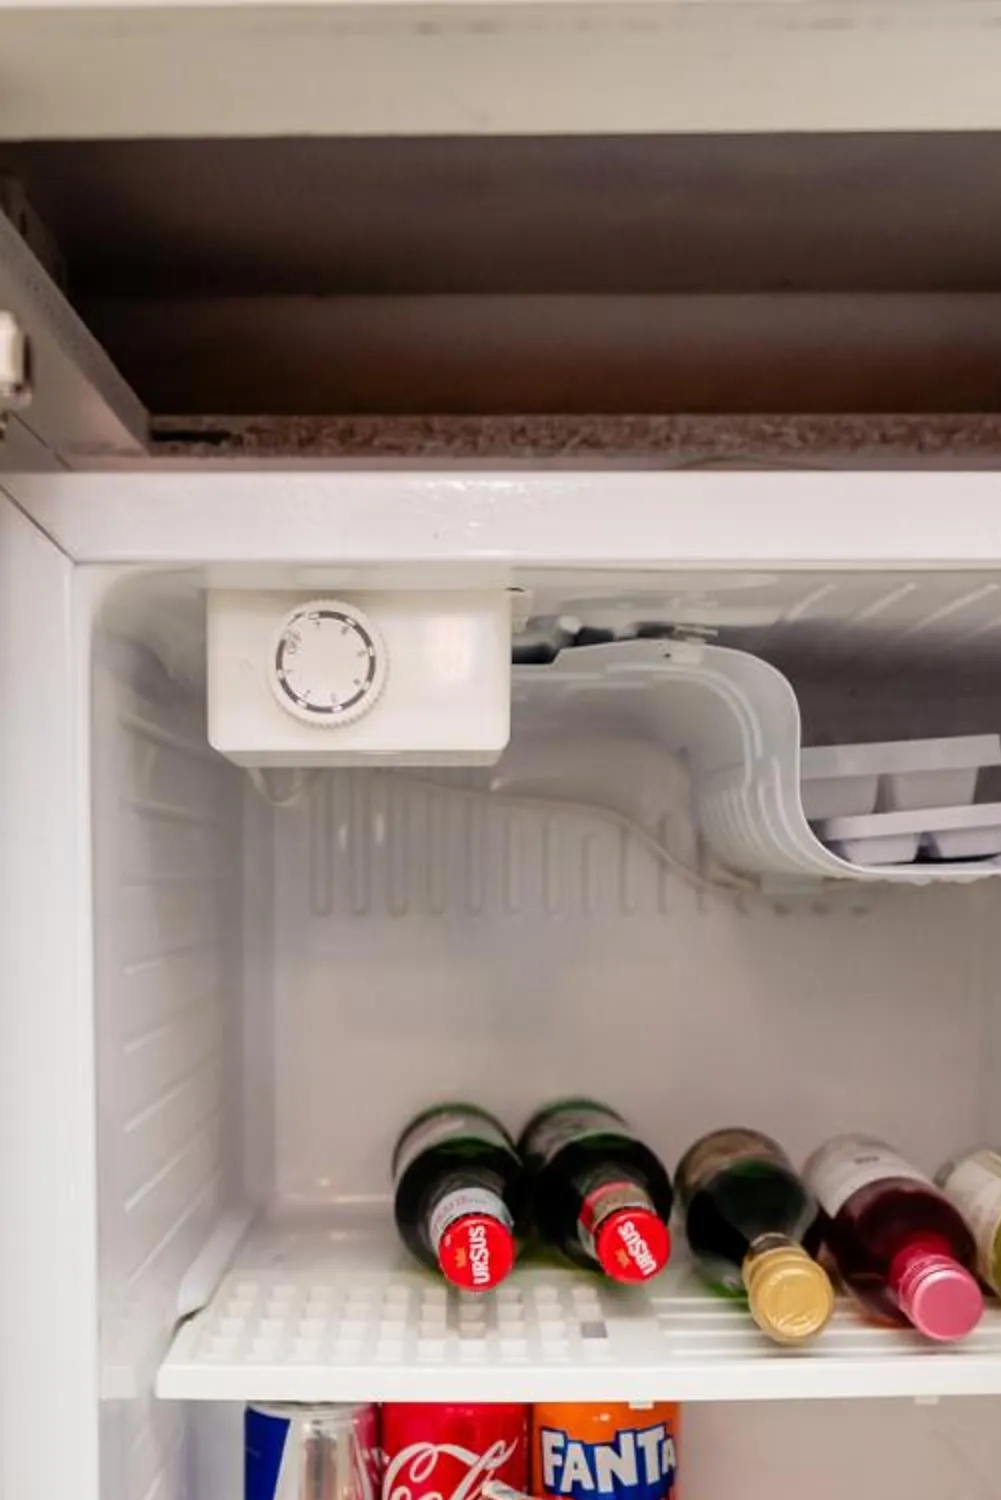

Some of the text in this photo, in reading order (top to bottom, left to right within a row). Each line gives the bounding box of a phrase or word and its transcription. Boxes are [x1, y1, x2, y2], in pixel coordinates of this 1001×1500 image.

[468, 1225, 490, 1285] URSUS
[617, 1220, 658, 1276] URSUS
[541, 1424, 676, 1494] FANTA
